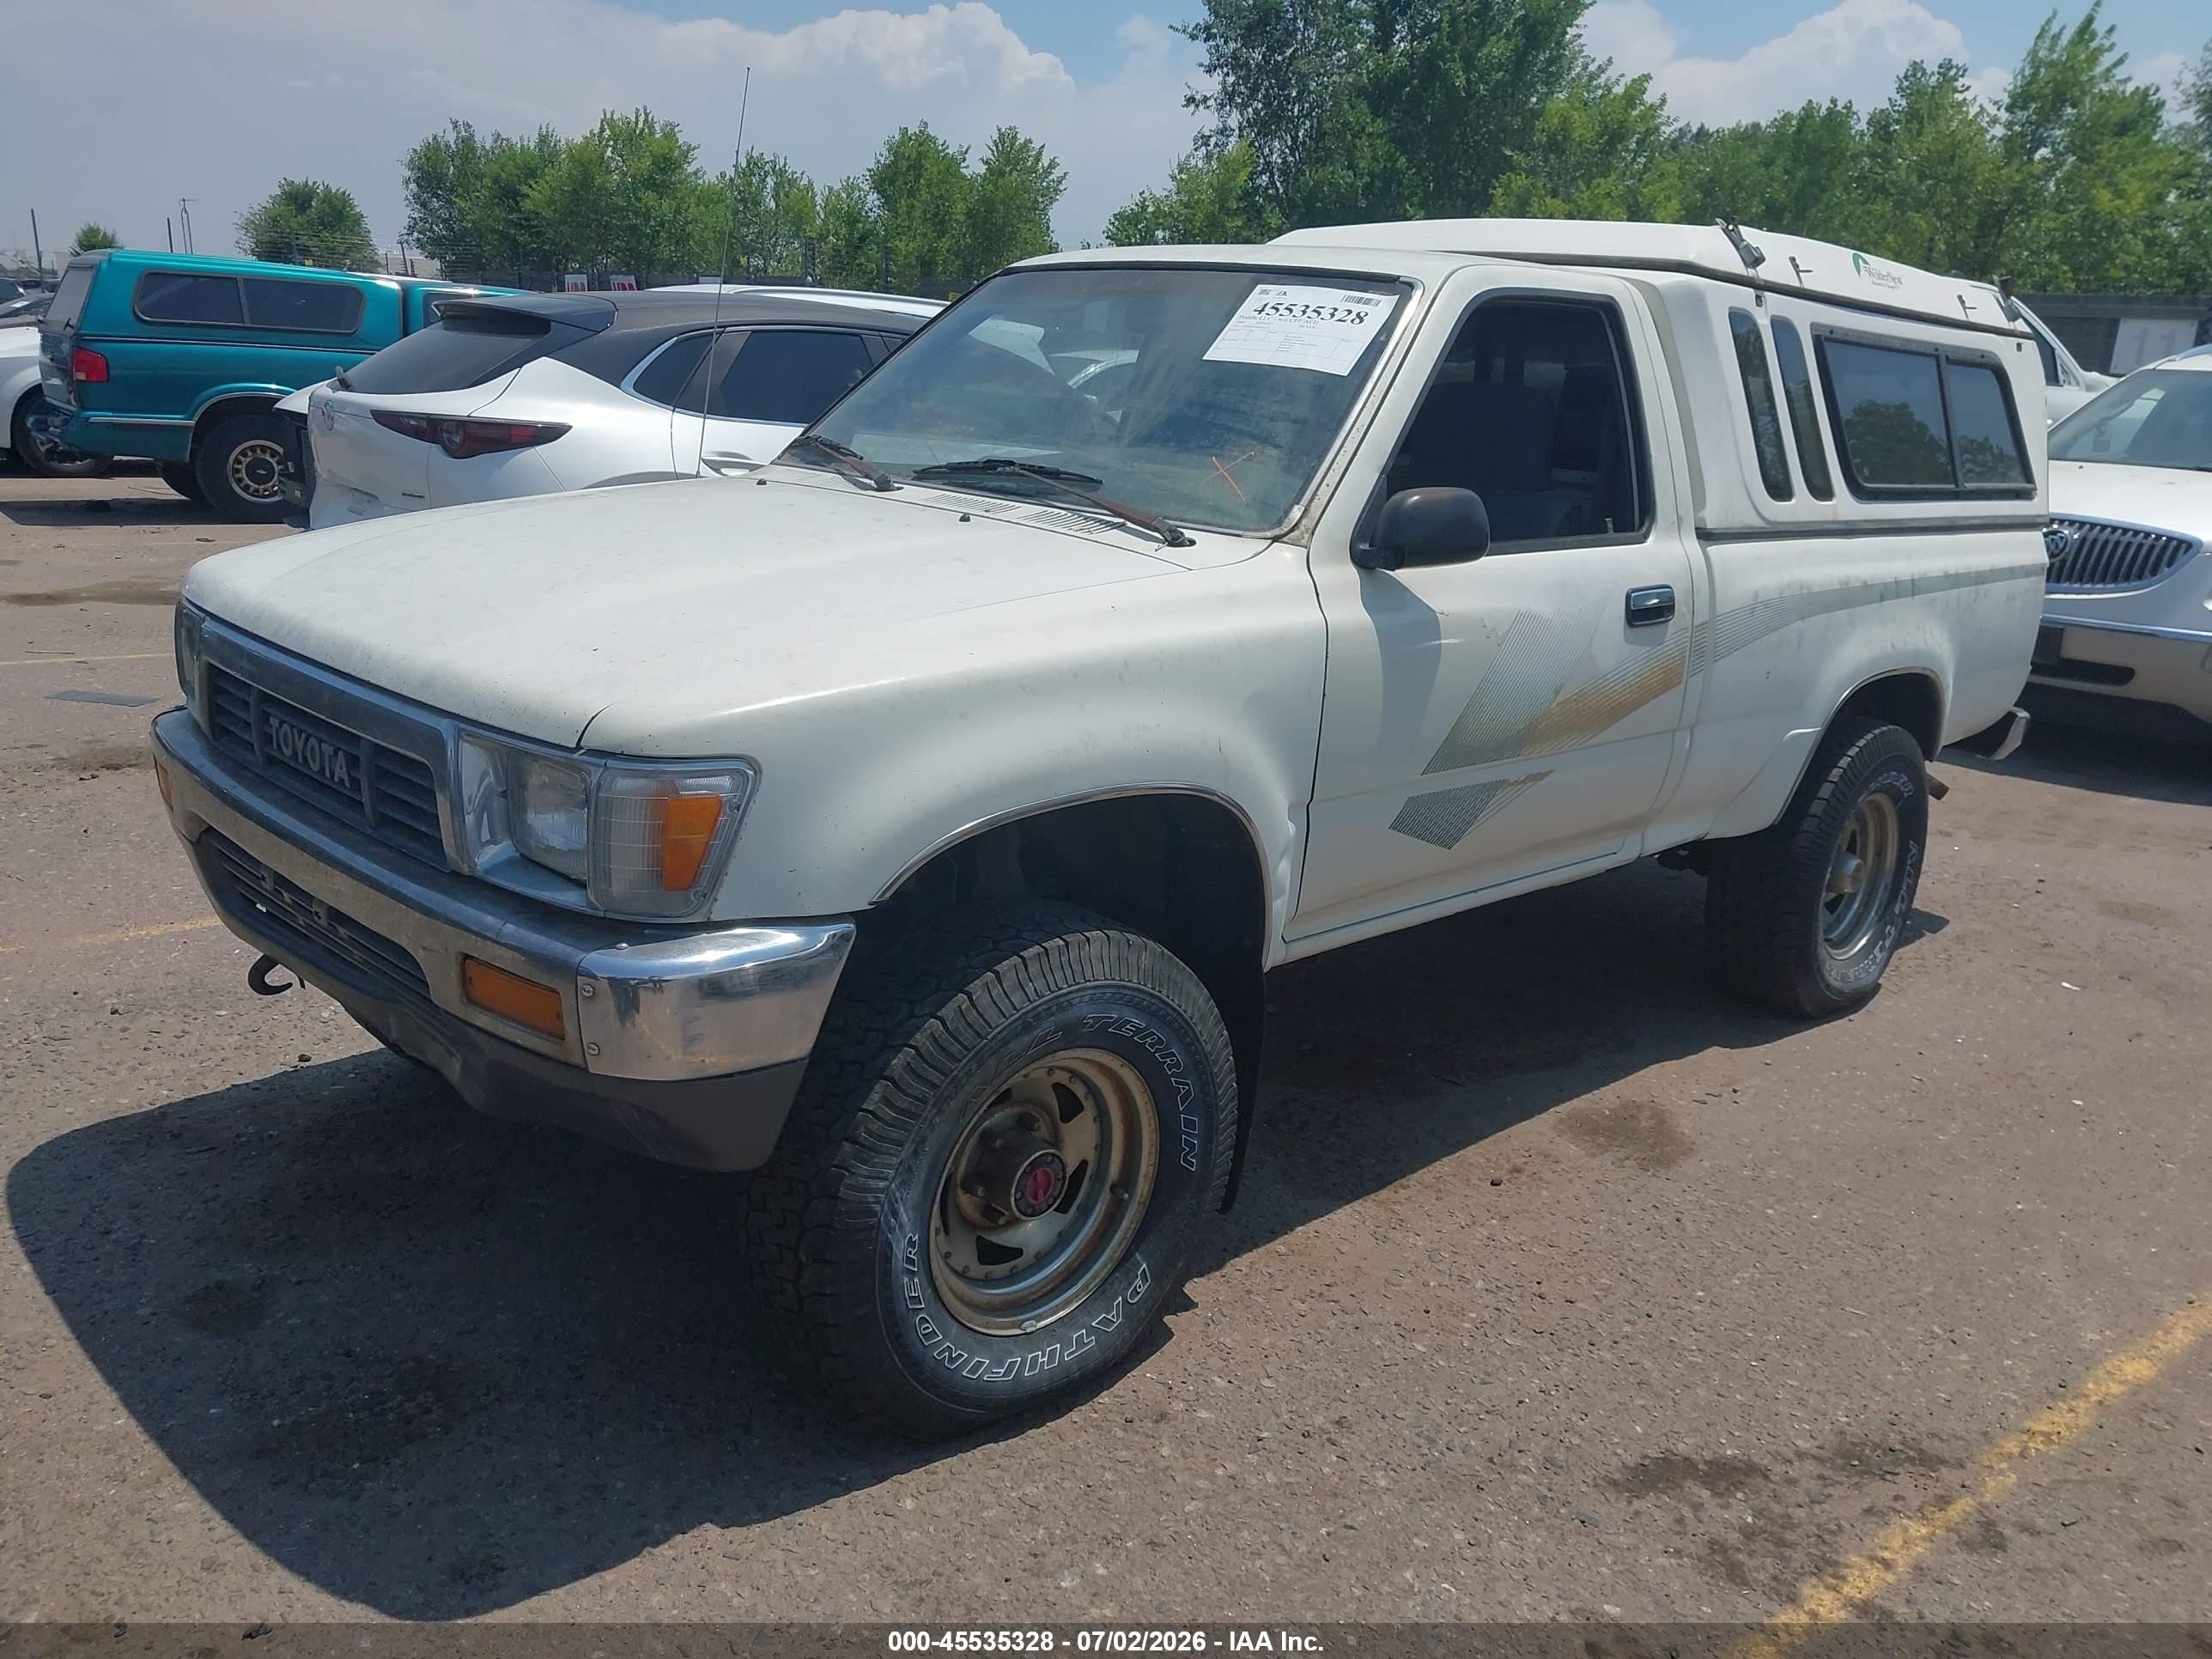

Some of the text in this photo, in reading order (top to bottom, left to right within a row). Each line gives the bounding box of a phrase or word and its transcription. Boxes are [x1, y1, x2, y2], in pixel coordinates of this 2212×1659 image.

[1253, 301, 1369, 325] 45535328
[269, 715, 350, 788] TOYOTA
[958, 1014, 1199, 1172] ALL TERRAIN
[903, 1232, 1152, 1382] PATHFINDER
